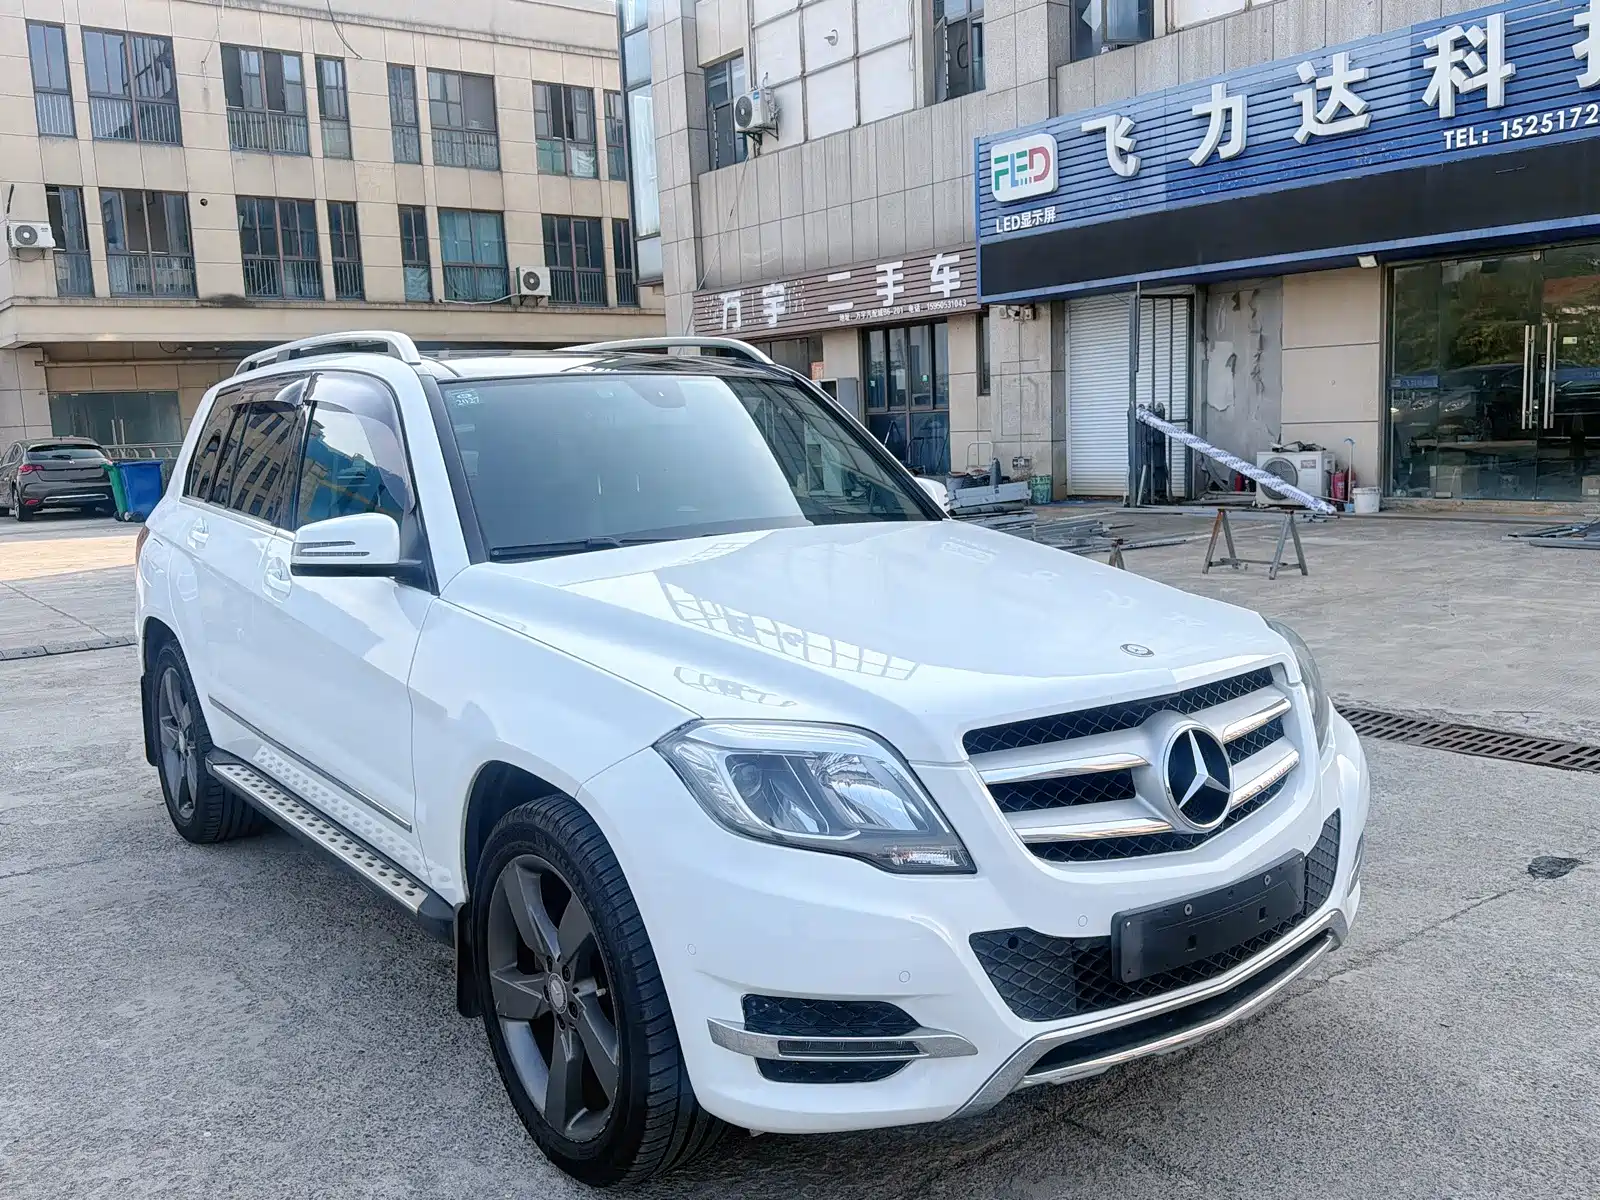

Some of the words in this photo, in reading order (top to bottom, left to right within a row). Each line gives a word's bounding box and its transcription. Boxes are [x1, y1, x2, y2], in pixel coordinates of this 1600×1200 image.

[1500, 103, 1600, 140] 1525172
[996, 206, 1057, 233] LED显示屏
